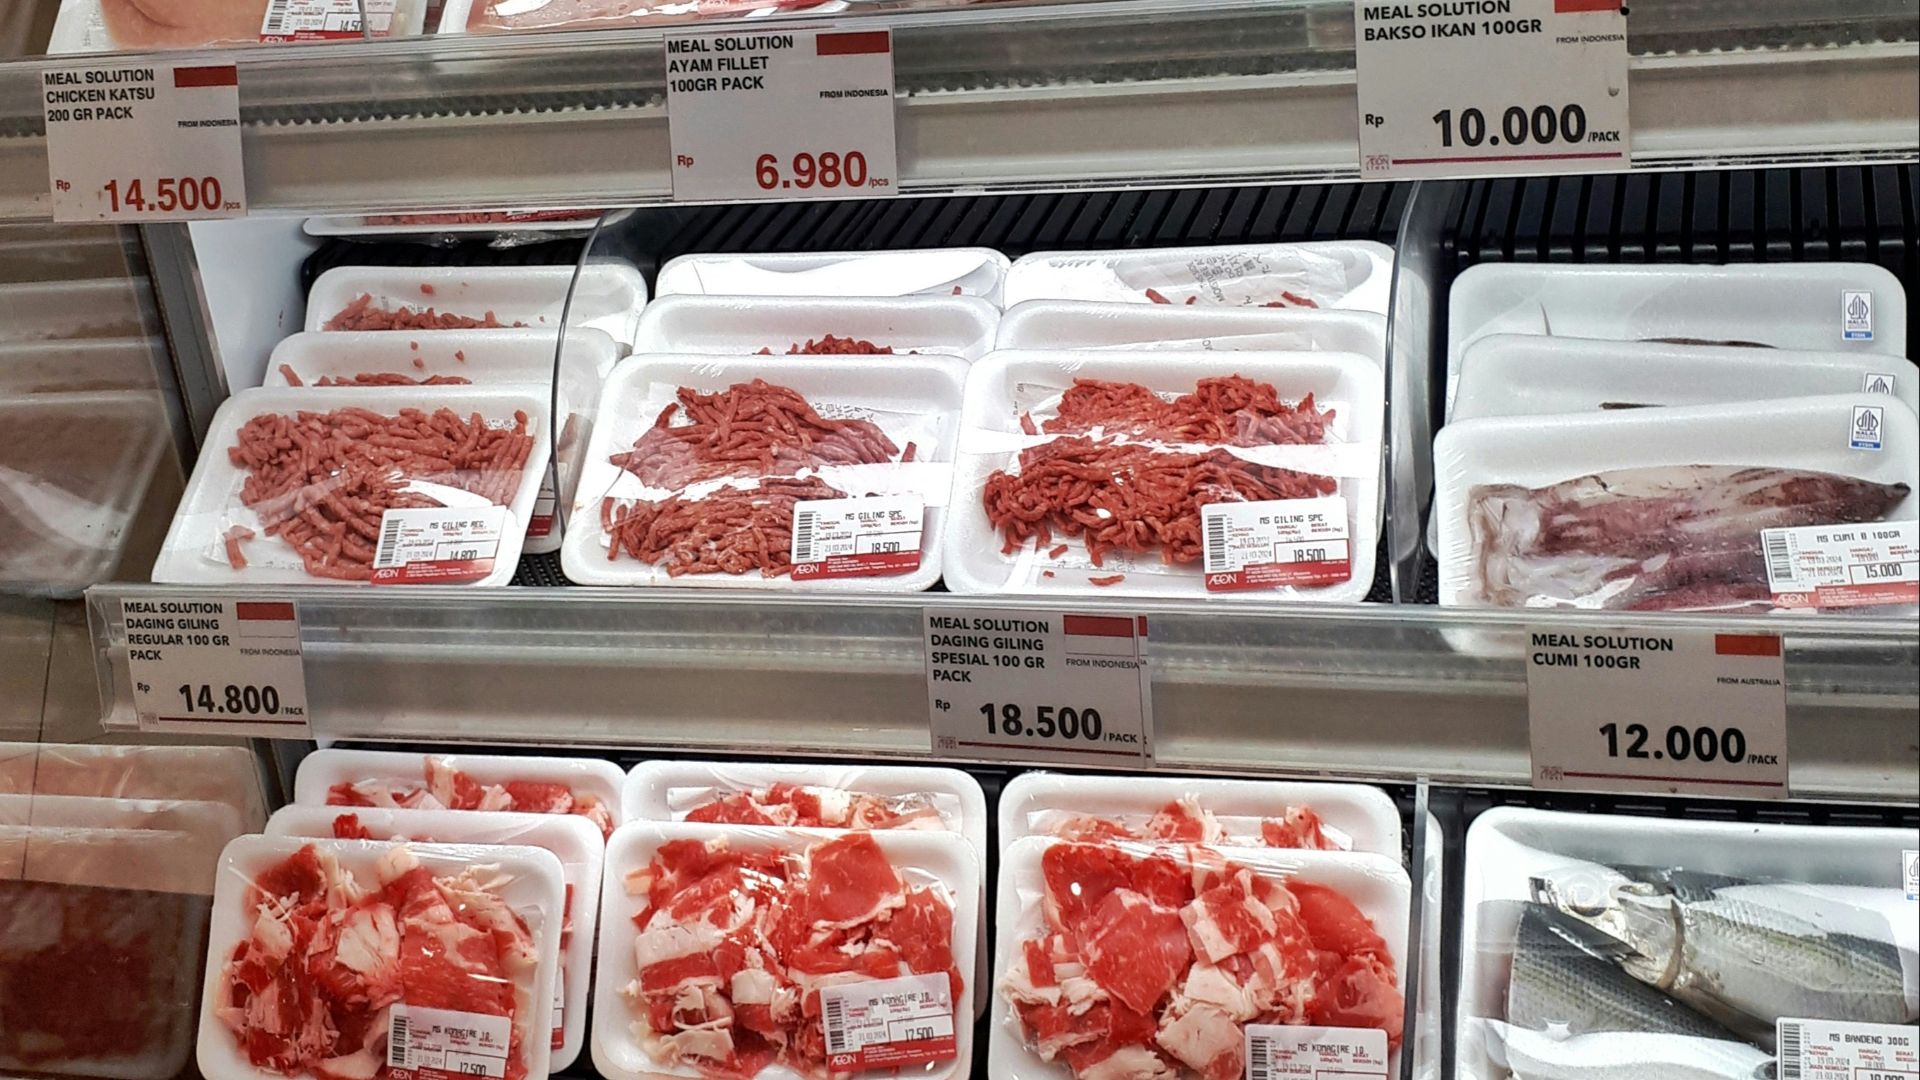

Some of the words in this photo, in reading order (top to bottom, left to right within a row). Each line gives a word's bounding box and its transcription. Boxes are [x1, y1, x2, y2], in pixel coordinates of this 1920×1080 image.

[1364, 6, 1413, 21] MEAL
[1418, 0, 1510, 17] SOLUTION
[1364, 25, 1425, 41] BAKSO
[1432, 22, 1475, 37] IKAN
[1482, 19, 1542, 34] 100GR
[668, 40, 710, 53] MEAL
[715, 36, 793, 51] SOLUTION
[1556, 36, 1578, 44] FROM
[1581, 34, 1624, 43] INDONESIA
[669, 59, 712, 72] AYAM
[718, 57, 768, 70] FILLET
[45, 72, 81, 85] MEAL
[85, 69, 154, 83] SOLUTION
[671, 78, 717, 92] 100GR
[722, 76, 763, 90] PACK
[46, 89, 106, 103] CHICKEN
[110, 88, 155, 100] KATSU
[845, 89, 888, 97] INDONESIA
[48, 109, 69, 121] 200
[73, 109, 92, 121] GR
[97, 107, 133, 120] PACK
[1365, 114, 1383, 128] Rp
[1432, 104, 1586, 147] 10.000
[677, 155, 693, 168] Rp
[756, 151, 866, 189] 6.980
[57, 180, 70, 191] Rp
[104, 177, 221, 212] 14.500
[1274, 515, 1303, 523] GILING
[450, 550, 477, 560] 14800
[872, 542, 899, 554] 18500
[1294, 548, 1325, 563] 18500
[1864, 563, 1902, 578] 15.000
[124, 603, 158, 613] MEAL
[161, 603, 222, 613] SOLUTION
[127, 619, 174, 629] DAGING
[178, 620, 219, 629] GILING
[930, 617, 970, 629] MEAL
[974, 619, 1049, 633] SOLUTION
[128, 635, 183, 645] REGULAR
[187, 635, 209, 645] 100
[213, 636, 229, 646] GR
[931, 635, 989, 648] DAGING
[994, 637, 1044, 650] GILING
[1532, 634, 1579, 648] MEAL
[1584, 636, 1673, 651] SOLUTION
[131, 650, 162, 660] PACK
[932, 652, 989, 666] SPESIAL
[994, 655, 1020, 667] 100
[1024, 656, 1044, 668] GR
[1533, 653, 1577, 666] CUMI
[1584, 655, 1640, 669] 100GR
[1066, 659, 1090, 667] FROM
[1092, 659, 1139, 668] INDONESIA
[933, 670, 971, 682] PACK
[1741, 678, 1780, 686] AUSTRALIA
[137, 683, 150, 693] Rp
[179, 685, 279, 714] 14.800
[936, 700, 950, 712] Rp
[980, 704, 1102, 740] 18.500
[1600, 724, 1746, 763] 12.000
[905, 1027, 934, 1041] 17500
[460, 1062, 486, 1076] 17500
